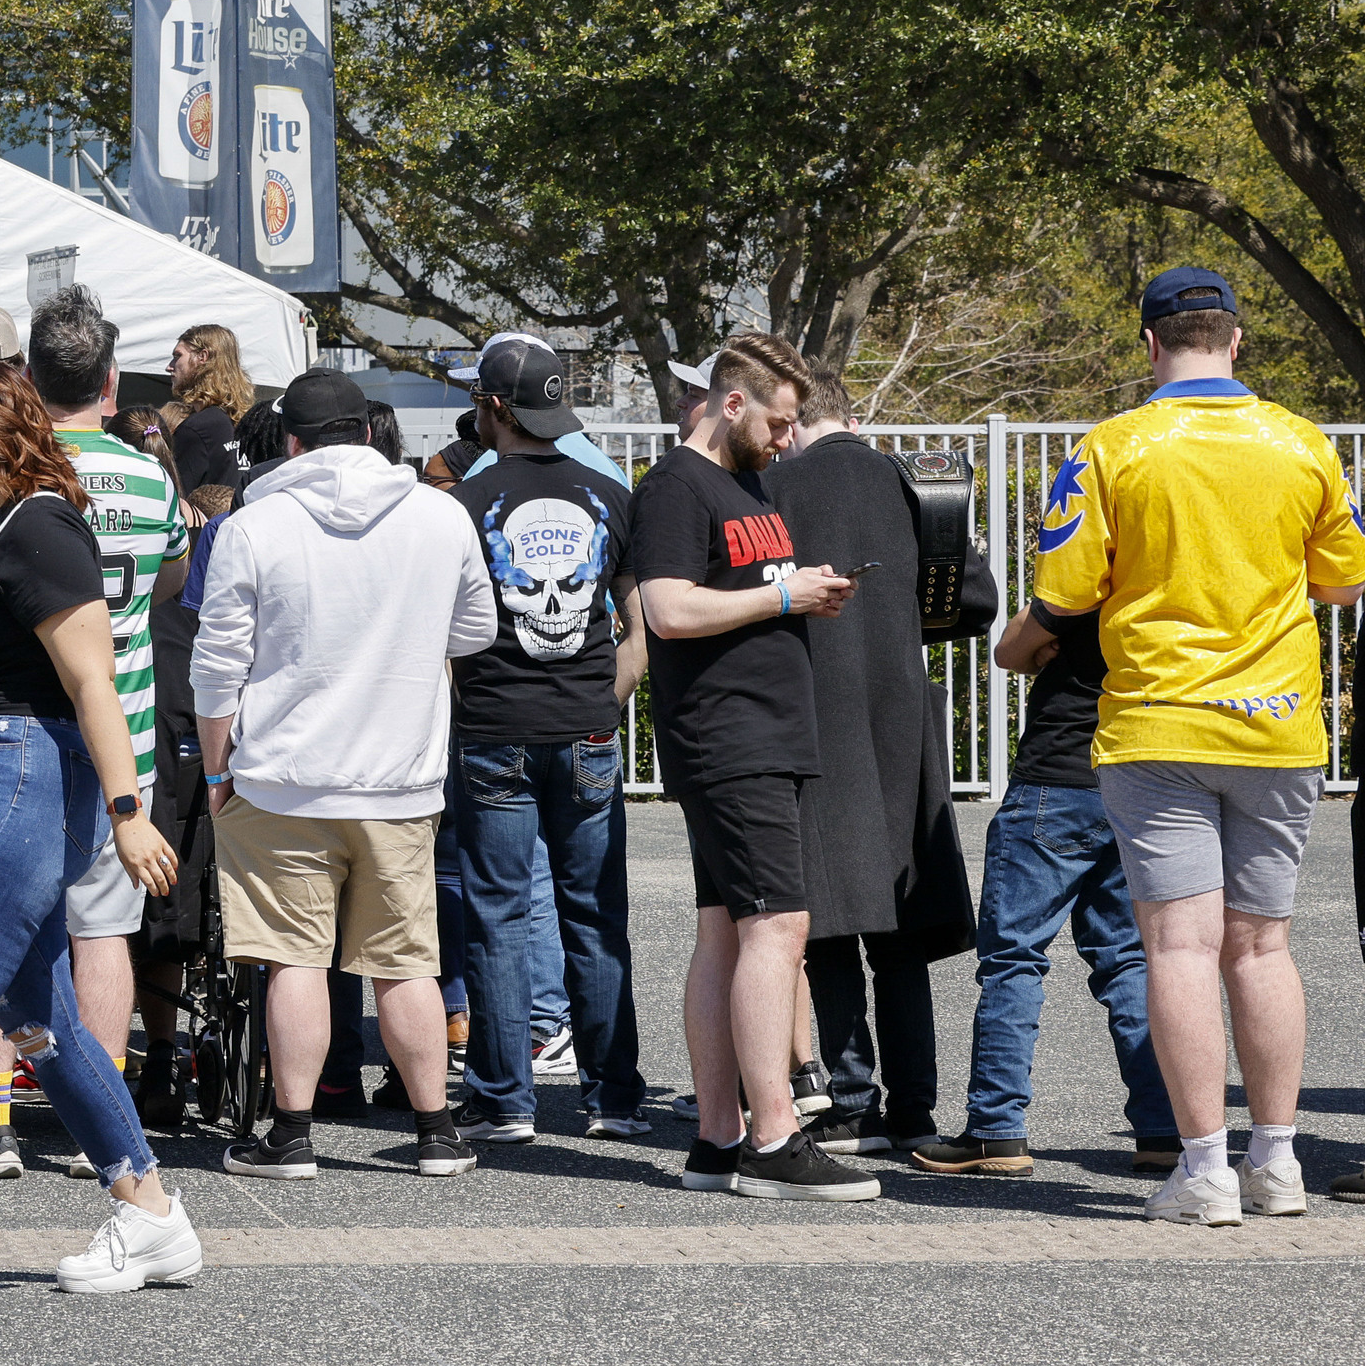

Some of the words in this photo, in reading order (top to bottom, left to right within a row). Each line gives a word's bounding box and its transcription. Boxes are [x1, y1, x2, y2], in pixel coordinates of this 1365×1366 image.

[248, 17, 308, 54] House
[183, 83, 206, 106] FINE
[257, 110, 302, 164] Lite
[519, 528, 584, 546] STONE
[524, 544, 576, 559] COLD
